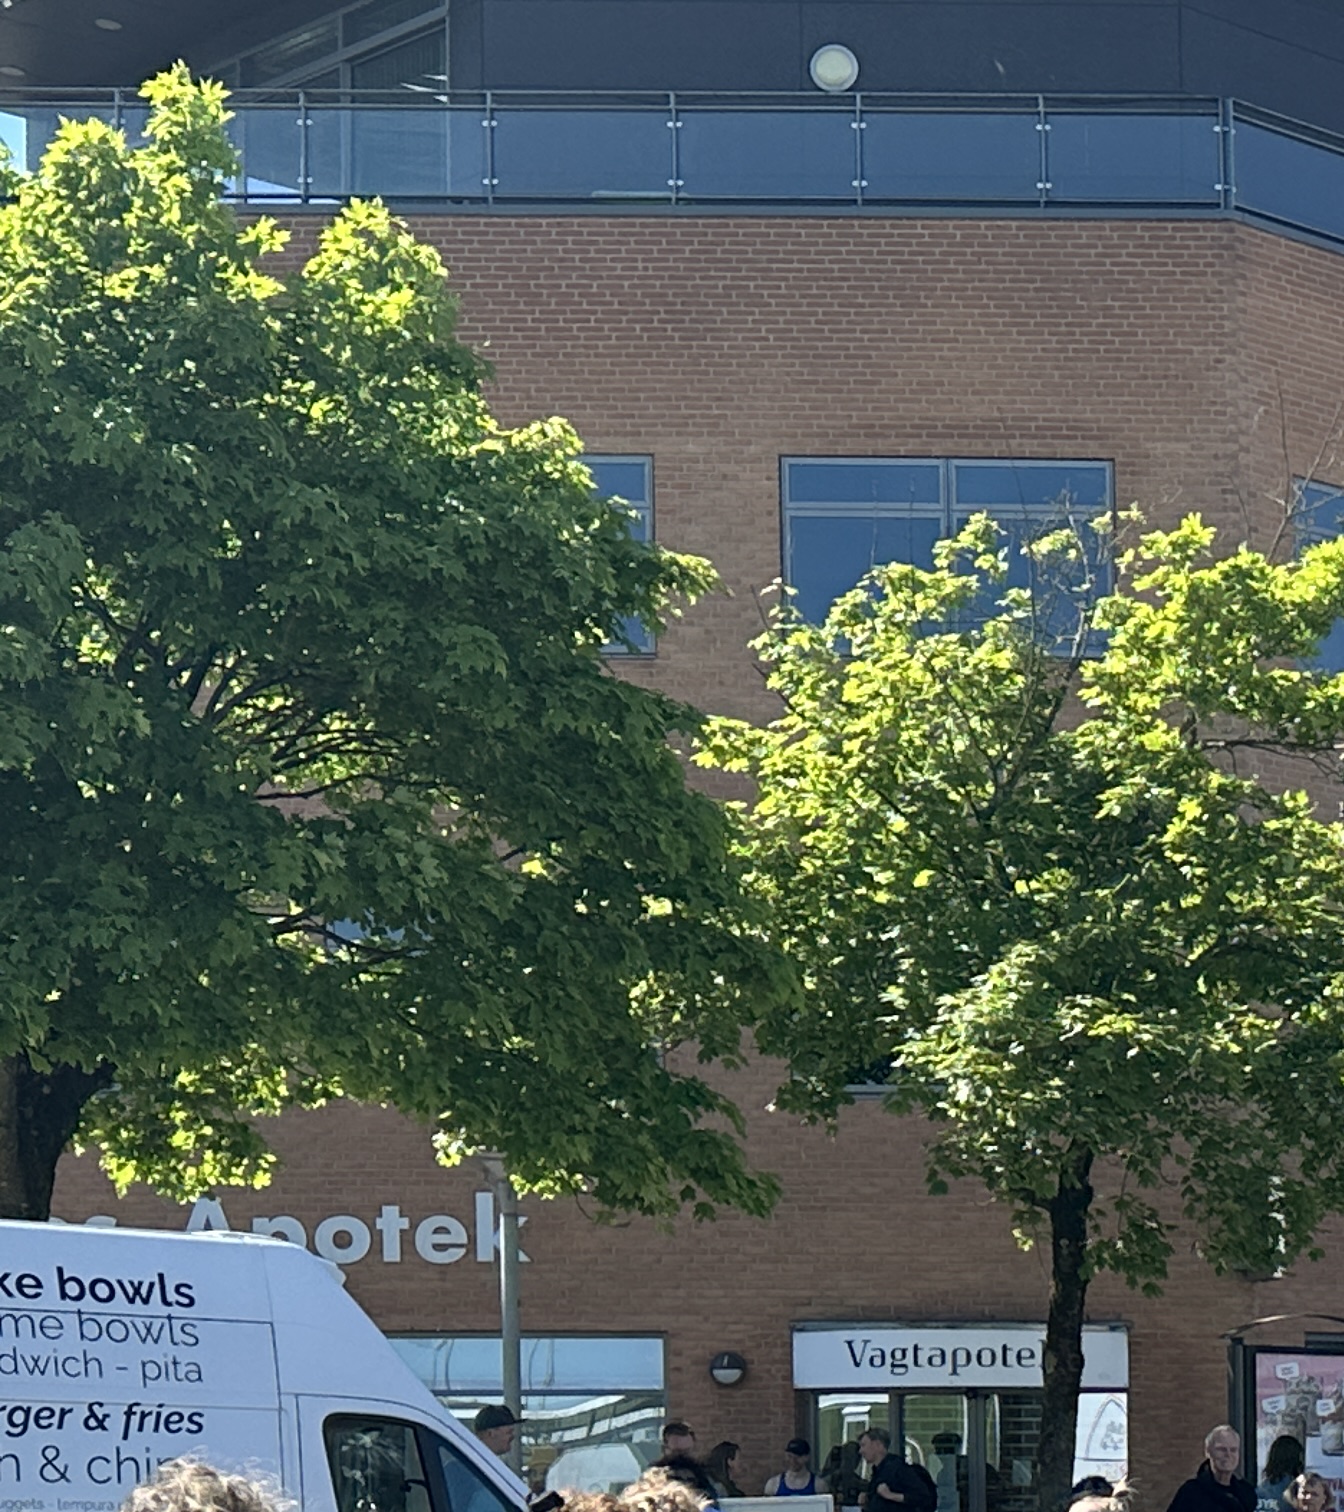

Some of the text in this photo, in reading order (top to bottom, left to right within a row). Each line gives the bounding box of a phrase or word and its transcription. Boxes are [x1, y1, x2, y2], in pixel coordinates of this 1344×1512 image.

[56, 1266, 196, 1308] bowls
[77, 1308, 199, 1347] bowls
[141, 1353, 204, 1389] pita
[83, 1401, 111, 1431] &
[122, 1402, 205, 1441] fries
[39, 1445, 71, 1484] &
[87, 1446, 182, 1484] chi
